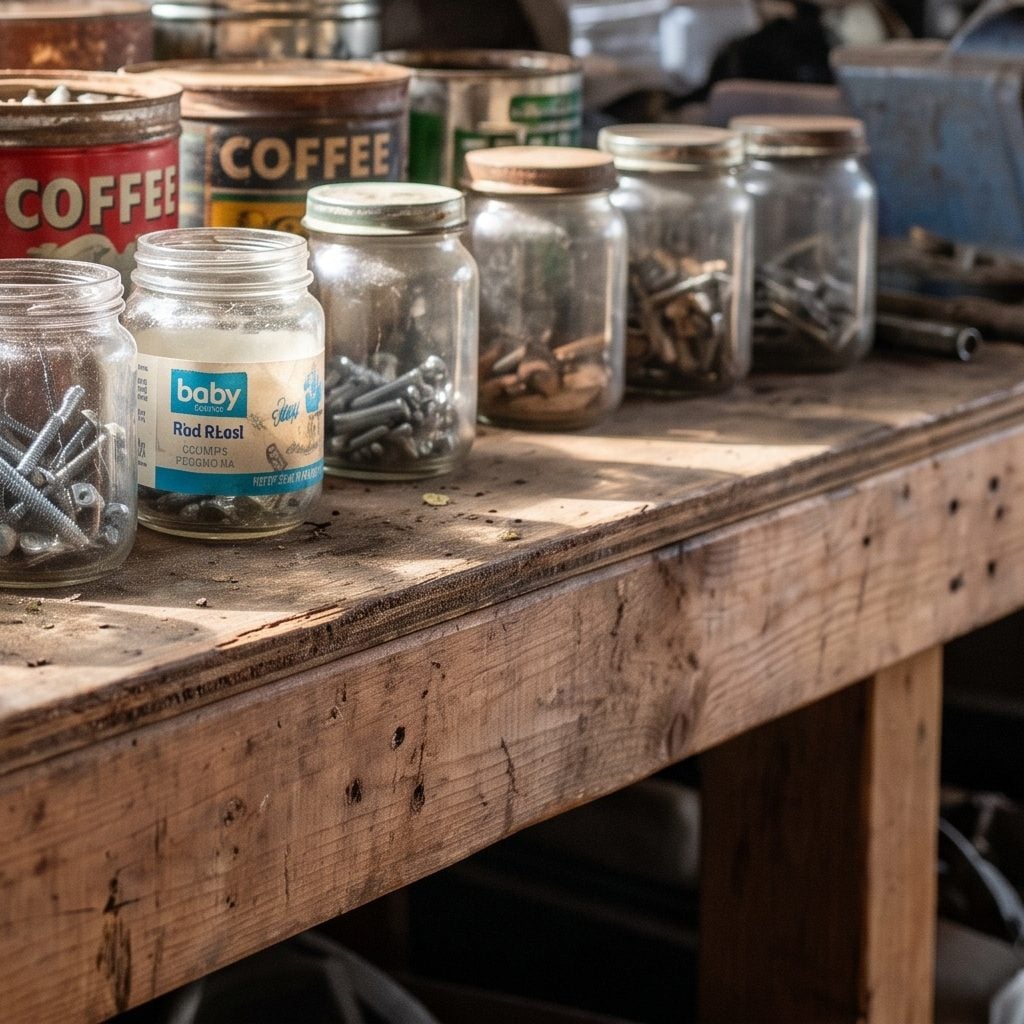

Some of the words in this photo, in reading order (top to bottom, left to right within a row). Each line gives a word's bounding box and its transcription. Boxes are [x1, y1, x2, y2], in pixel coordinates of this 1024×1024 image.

[219, 133, 391, 181] COFFEE
[5, 165, 176, 230] COFFEE
[178, 378, 242, 411] baby
